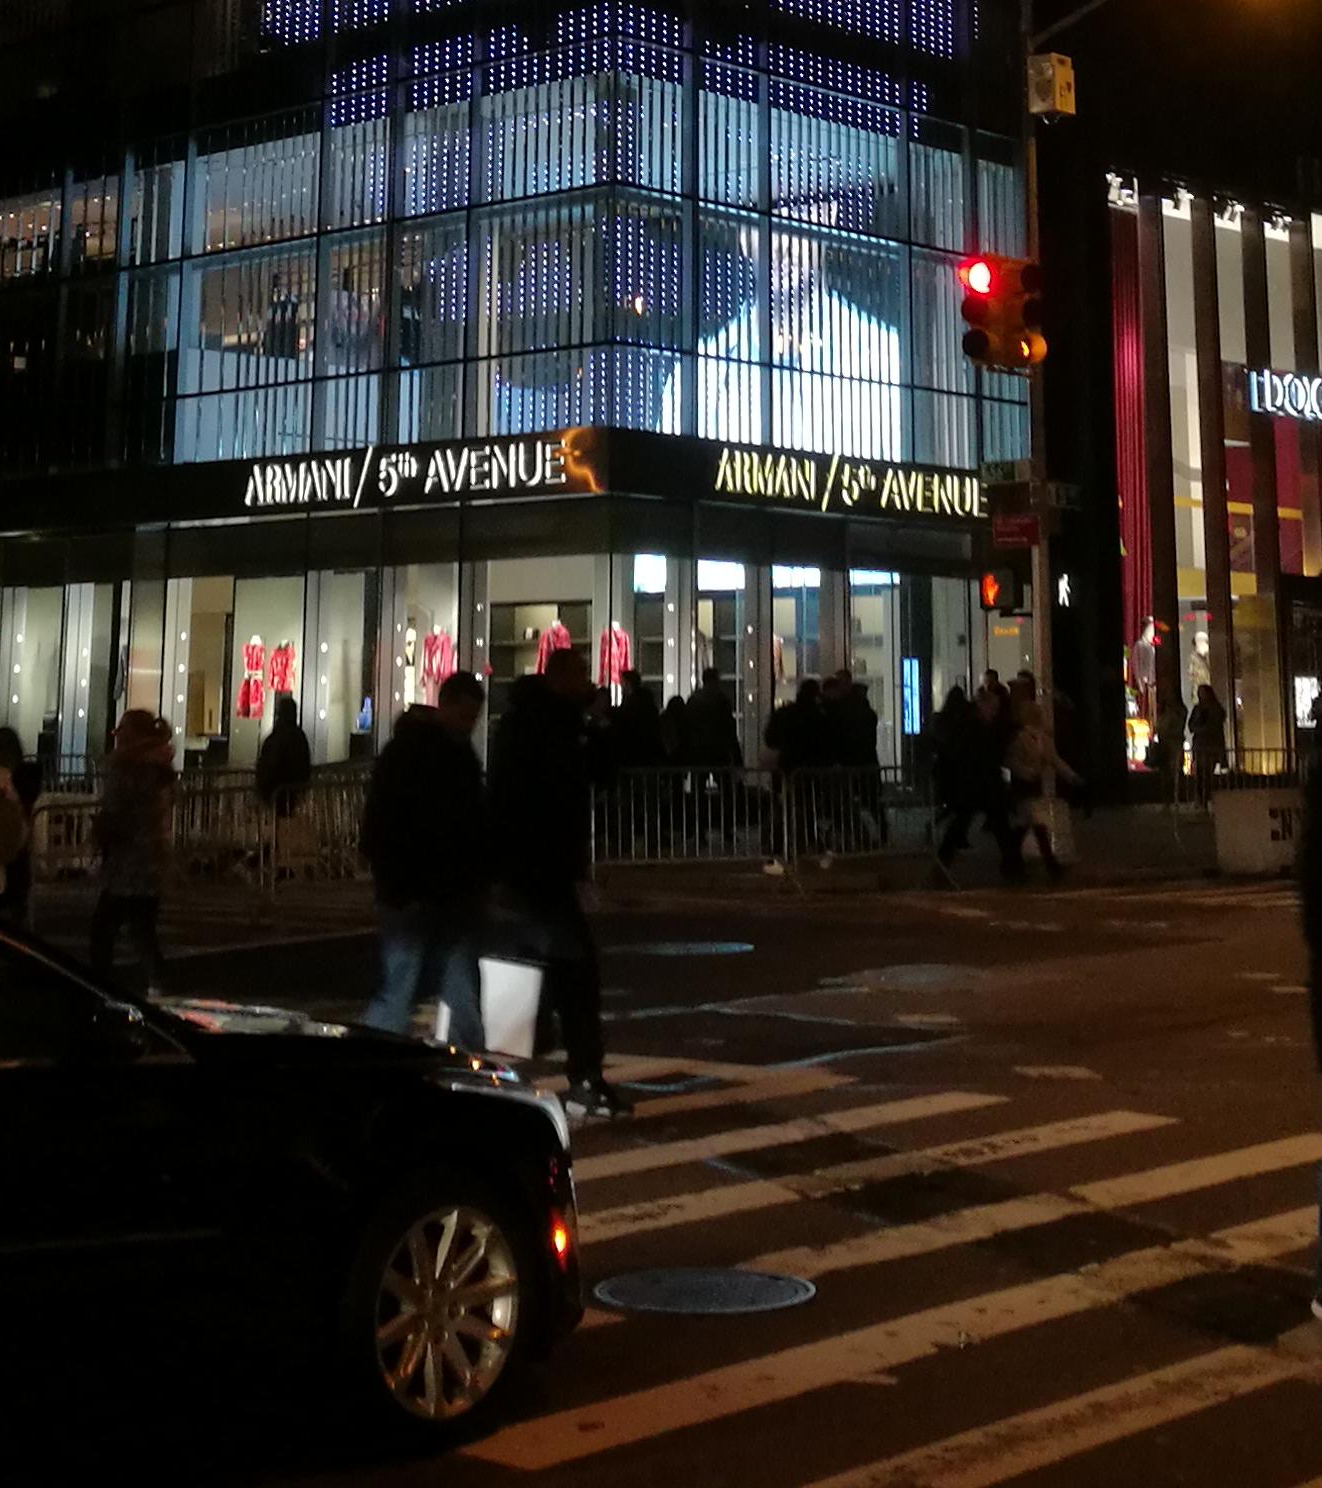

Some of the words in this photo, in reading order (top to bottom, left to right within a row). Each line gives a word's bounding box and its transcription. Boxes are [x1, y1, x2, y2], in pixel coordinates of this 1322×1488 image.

[244, 457, 352, 507] ARMANI
[424, 440, 566, 494] AVENUE
[715, 448, 816, 502] ARMANI
[880, 467, 989, 519] AVENUE
